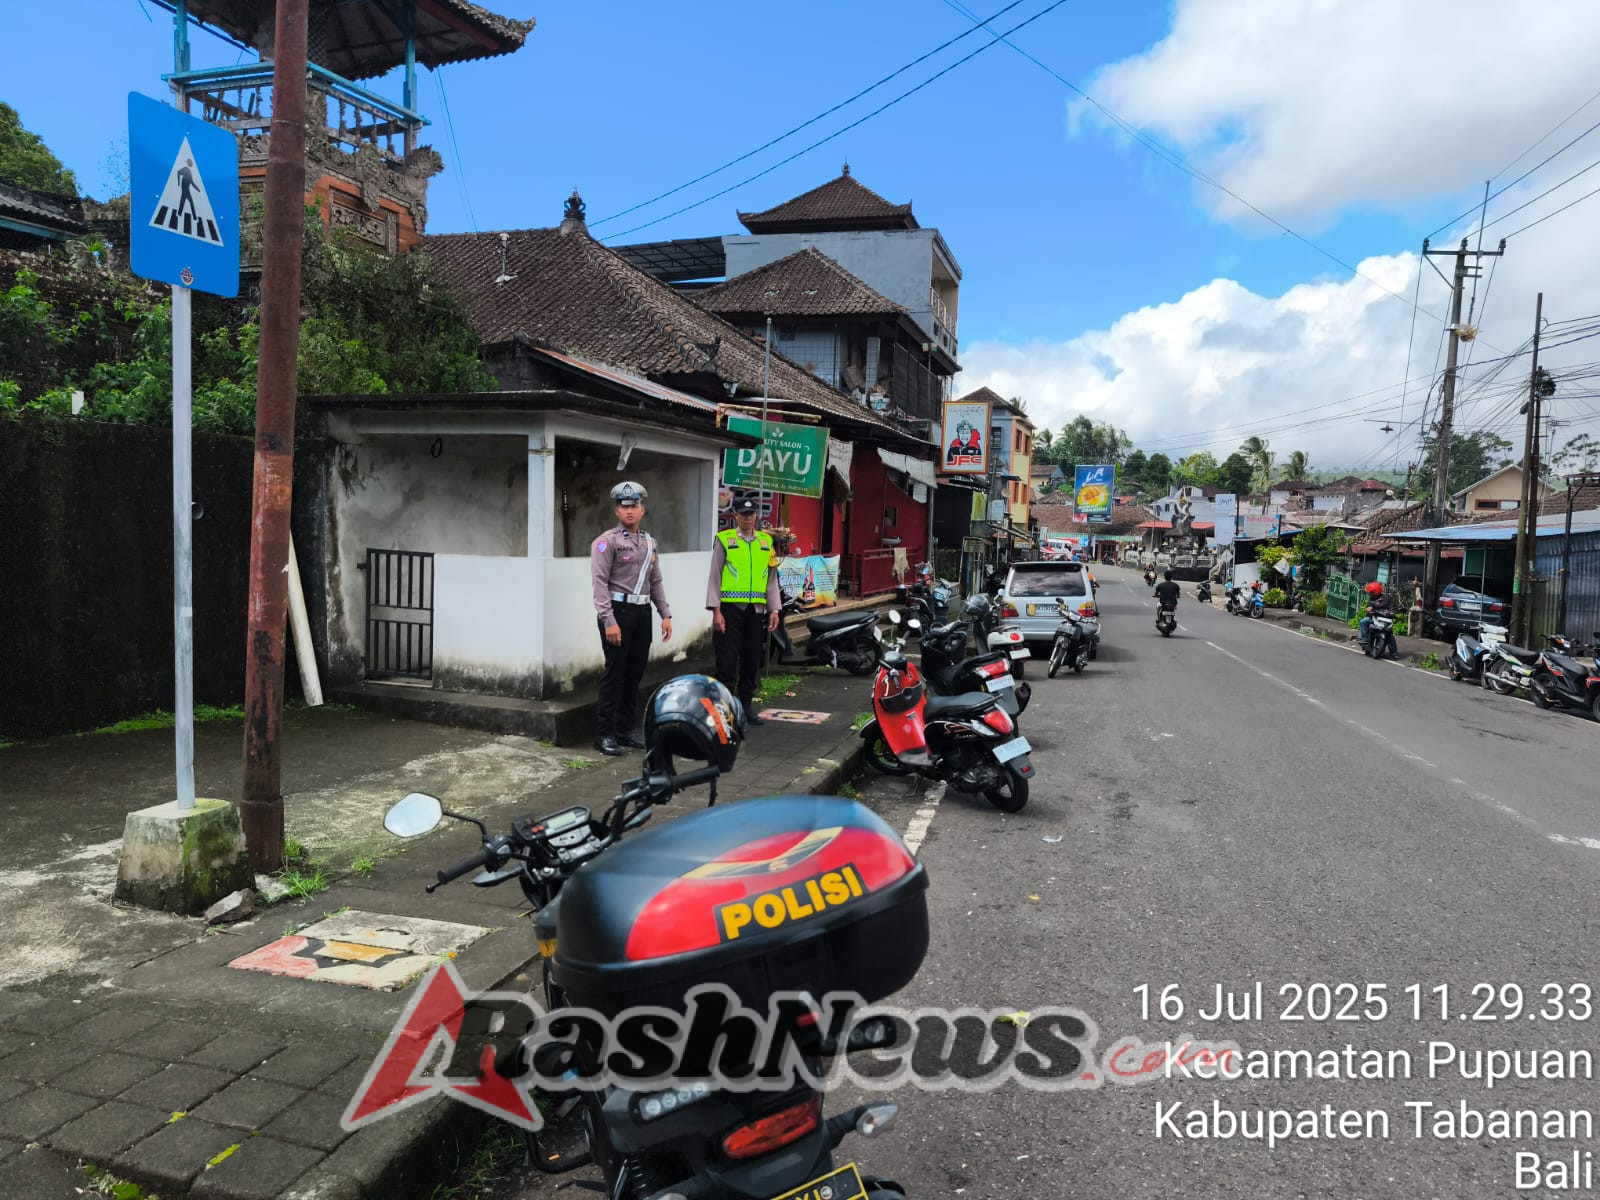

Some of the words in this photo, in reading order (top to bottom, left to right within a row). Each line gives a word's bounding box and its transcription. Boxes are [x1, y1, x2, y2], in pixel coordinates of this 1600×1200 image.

[779, 440, 802, 449] SALON
[737, 448, 812, 475] DAYU
[946, 455, 983, 466] JFC
[720, 866, 863, 940] POLISI
